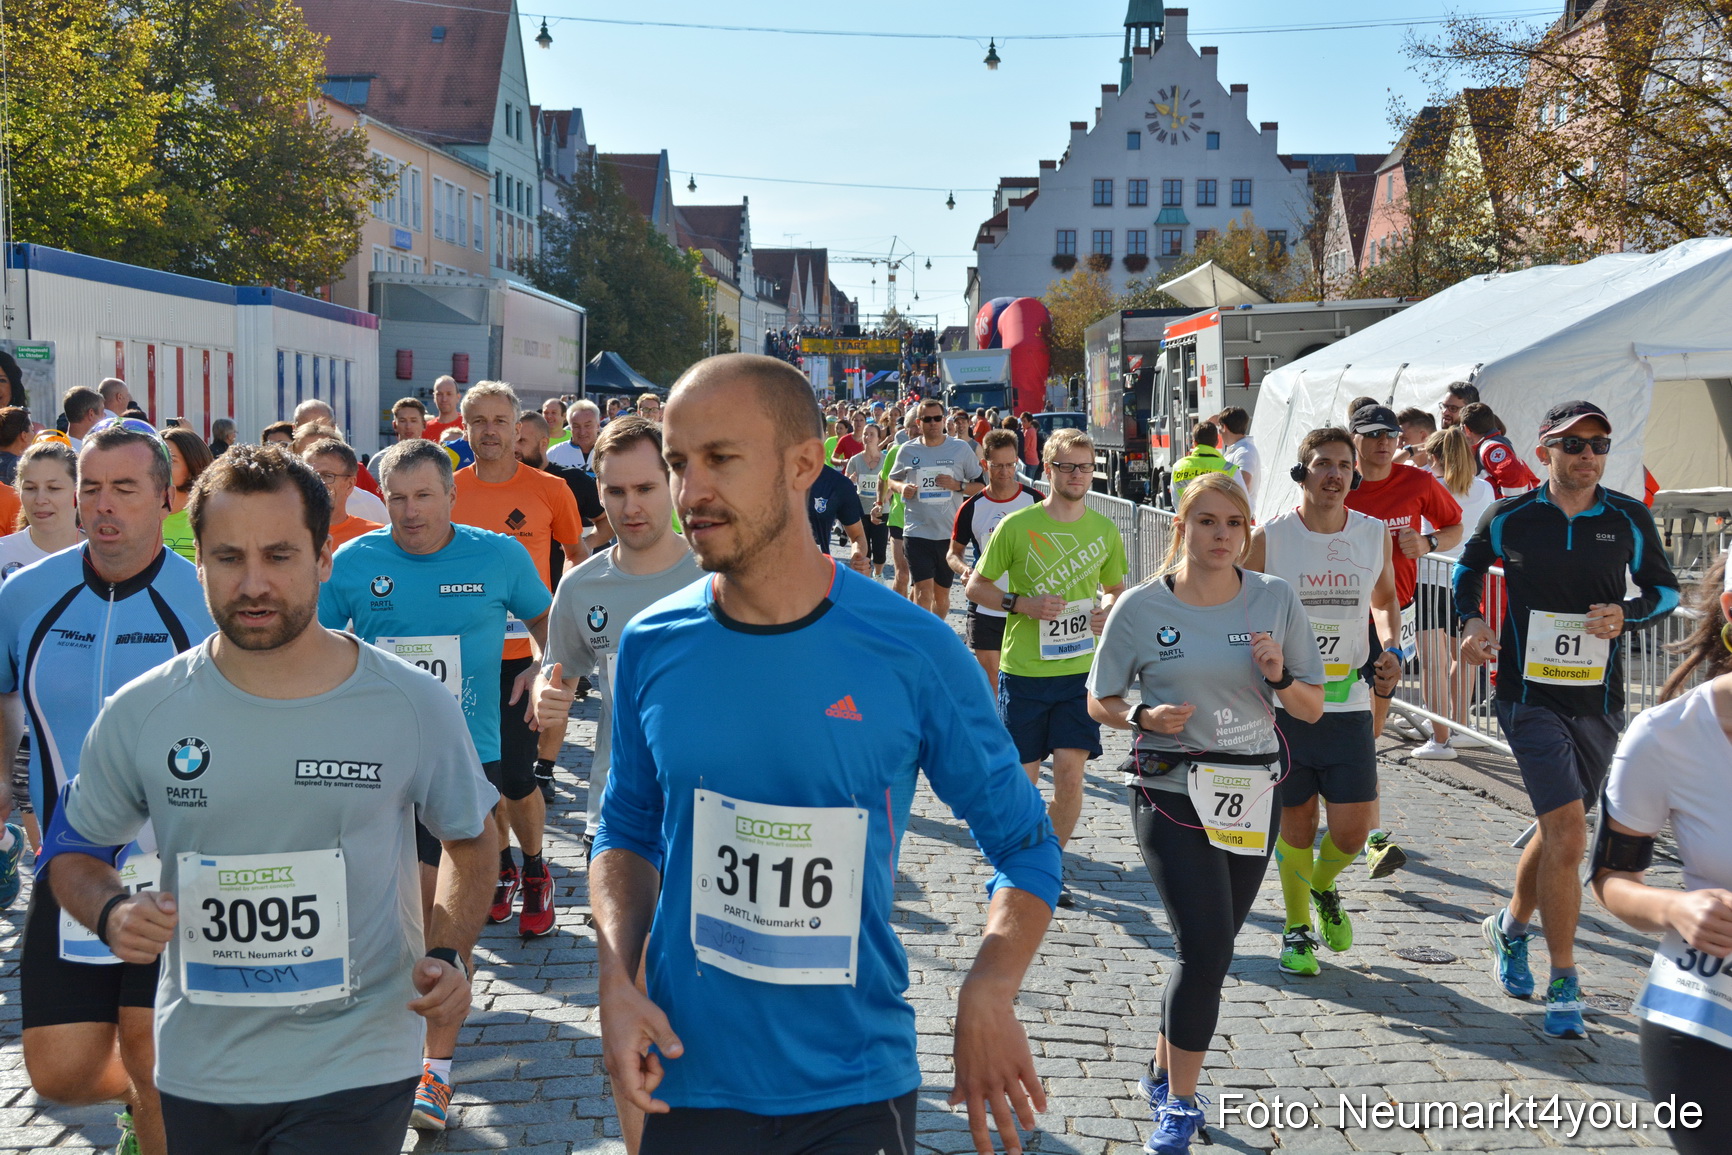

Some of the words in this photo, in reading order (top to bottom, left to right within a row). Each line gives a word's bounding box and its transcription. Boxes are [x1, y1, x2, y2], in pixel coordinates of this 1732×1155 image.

[833, 341, 868, 350] START
[1299, 570, 1360, 588] twinn
[439, 583, 485, 595] BOCK
[1049, 615, 1087, 637] 2162
[57, 641, 92, 650] NEUMARKT
[590, 636, 610, 644] PARTL
[1316, 636, 1341, 655] 27
[1555, 634, 1582, 656] 61
[395, 644, 433, 654] BOCK
[1159, 648, 1184, 657] PARTL
[1542, 666, 1590, 678] Schorschi
[825, 708, 862, 720] adidas
[1213, 708, 1239, 726] 19.
[1215, 719, 1263, 737] Neumarkter
[1218, 731, 1257, 747] Stadtlauf
[296, 760, 383, 782] BOCK
[294, 779, 323, 787] inspired
[324, 780, 333, 788] by
[354, 782, 382, 790] concepts
[1212, 775, 1252, 787] BOCK
[166, 787, 208, 800] PARTL
[168, 797, 208, 808] Neumarkt
[1214, 792, 1244, 818] 78
[736, 815, 813, 842] BOCK
[218, 866, 295, 886] BOCK
[702, 878, 708, 888] D
[716, 844, 834, 909] 3116
[202, 894, 320, 943] 3095
[724, 903, 752, 922] PARTL
[753, 914, 805, 928] Neumarkt
[188, 930, 194, 939] D
[212, 949, 246, 960] PARTL
[248, 949, 298, 960] Neumarkt
[214, 965, 299, 988] TOM
[1676, 978, 1701, 992] PARTL
